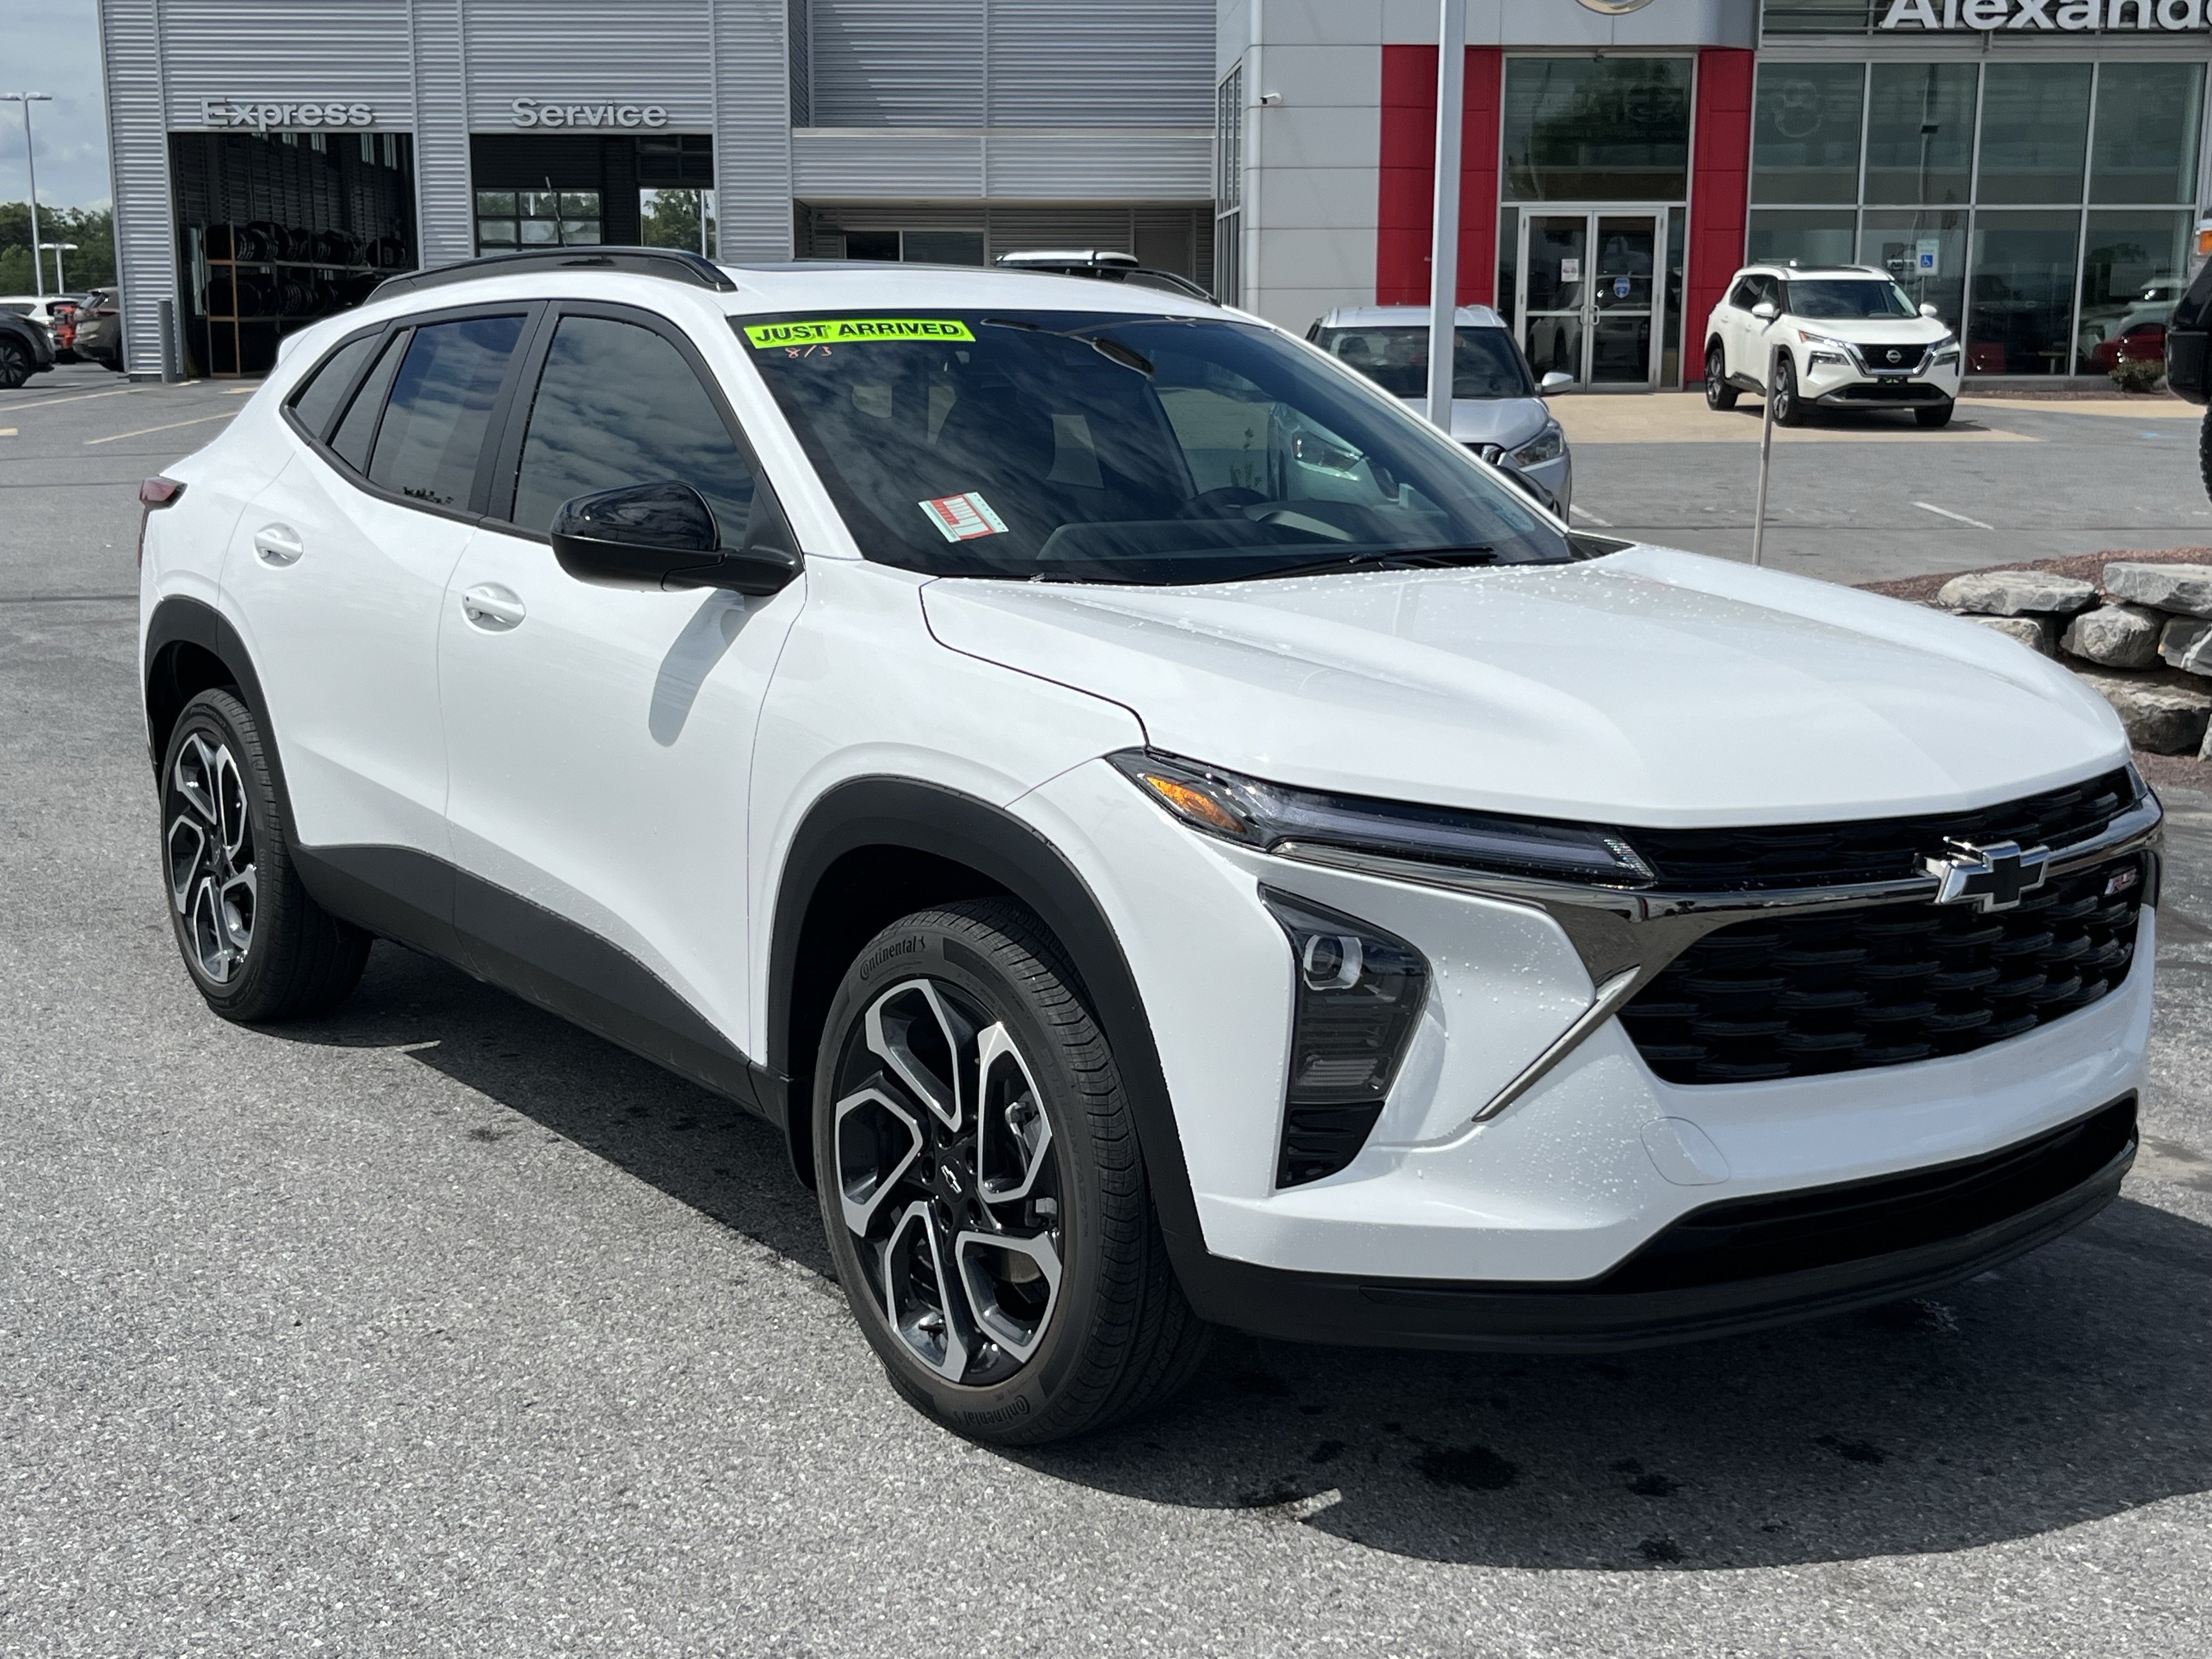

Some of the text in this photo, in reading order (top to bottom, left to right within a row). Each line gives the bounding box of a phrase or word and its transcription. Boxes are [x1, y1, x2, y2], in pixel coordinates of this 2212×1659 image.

[1882, 0, 2212, 30] Alexand
[201, 97, 373, 132] Express
[511, 98, 668, 128] Service
[755, 323, 960, 342] JUST ARRIVED
[860, 935, 917, 981] Continental
